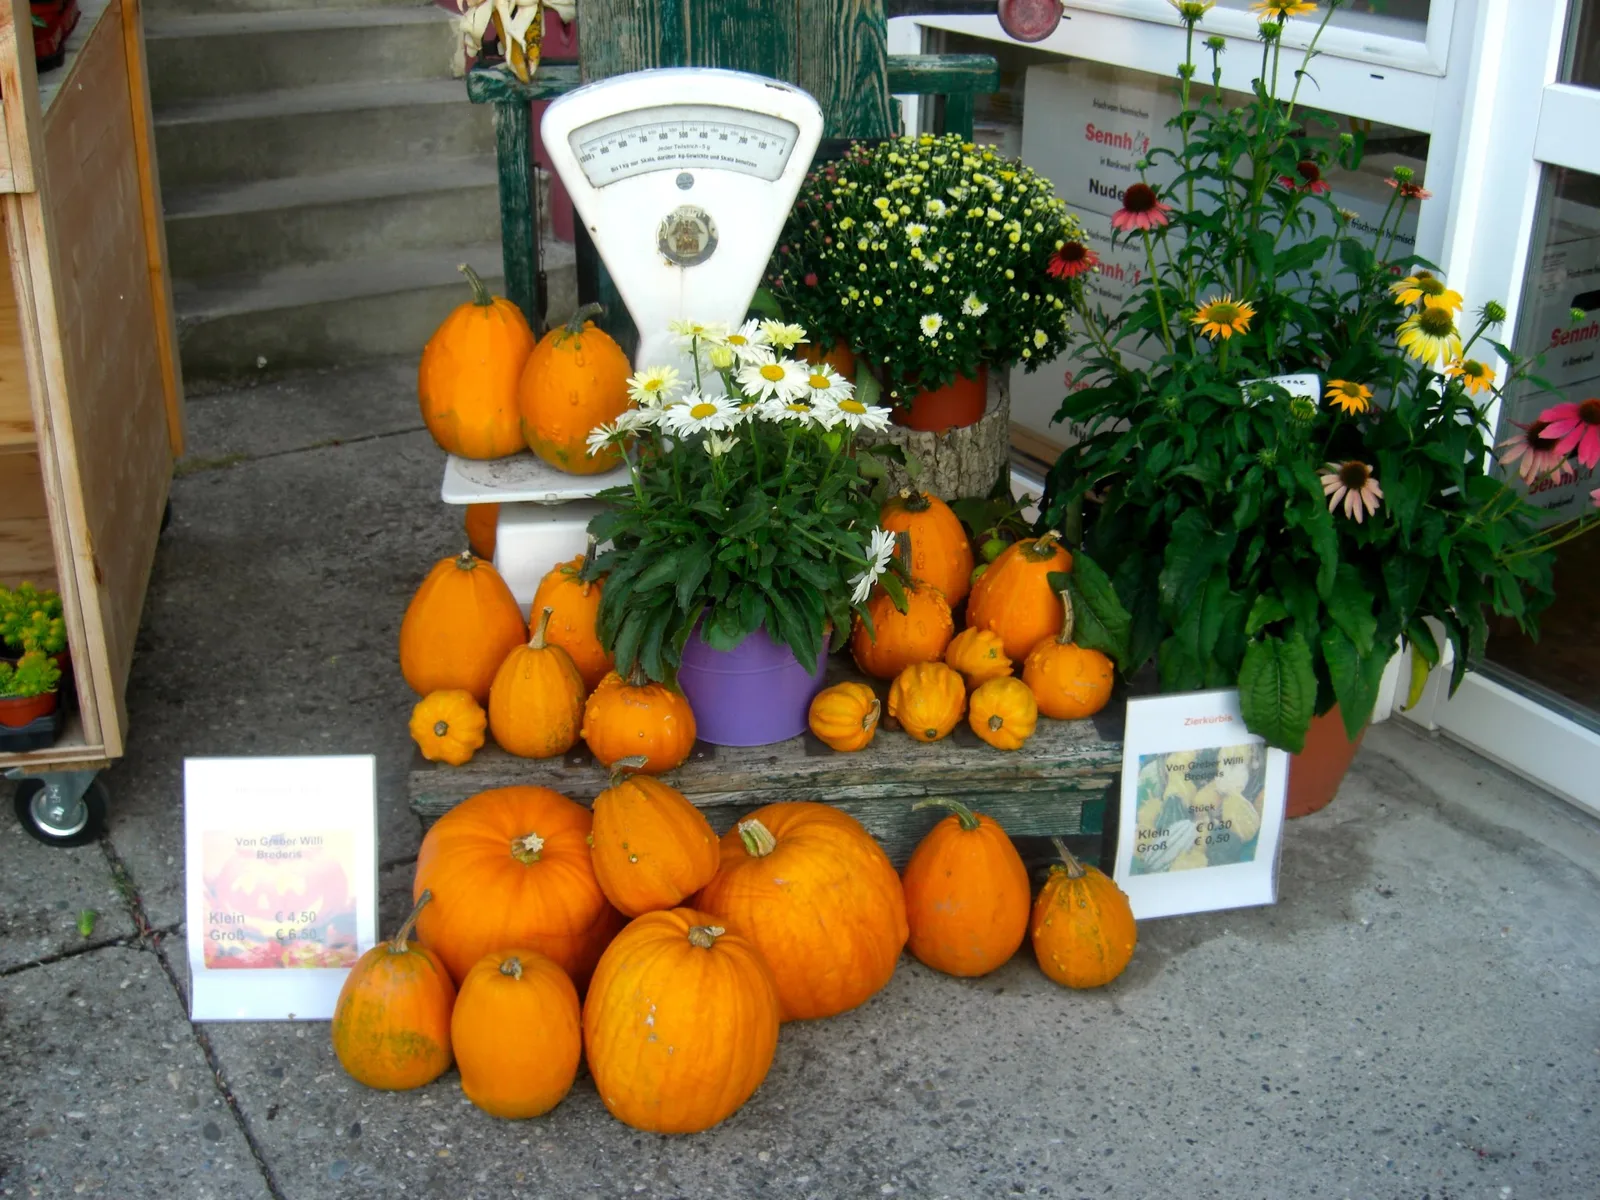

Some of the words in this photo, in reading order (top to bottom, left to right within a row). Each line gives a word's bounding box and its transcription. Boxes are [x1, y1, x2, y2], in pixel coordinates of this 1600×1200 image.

[1166, 763, 1185, 772] Von
[1223, 756, 1244, 766] Willi
[1188, 803, 1215, 814] Stück
[1138, 828, 1170, 840] Klein
[235, 837, 257, 847] Von
[300, 836, 323, 846] Willi
[1137, 840, 1168, 853] Groß
[209, 911, 245, 924] Klein
[288, 911, 317, 925] 4,50
[209, 928, 245, 941] Groß
